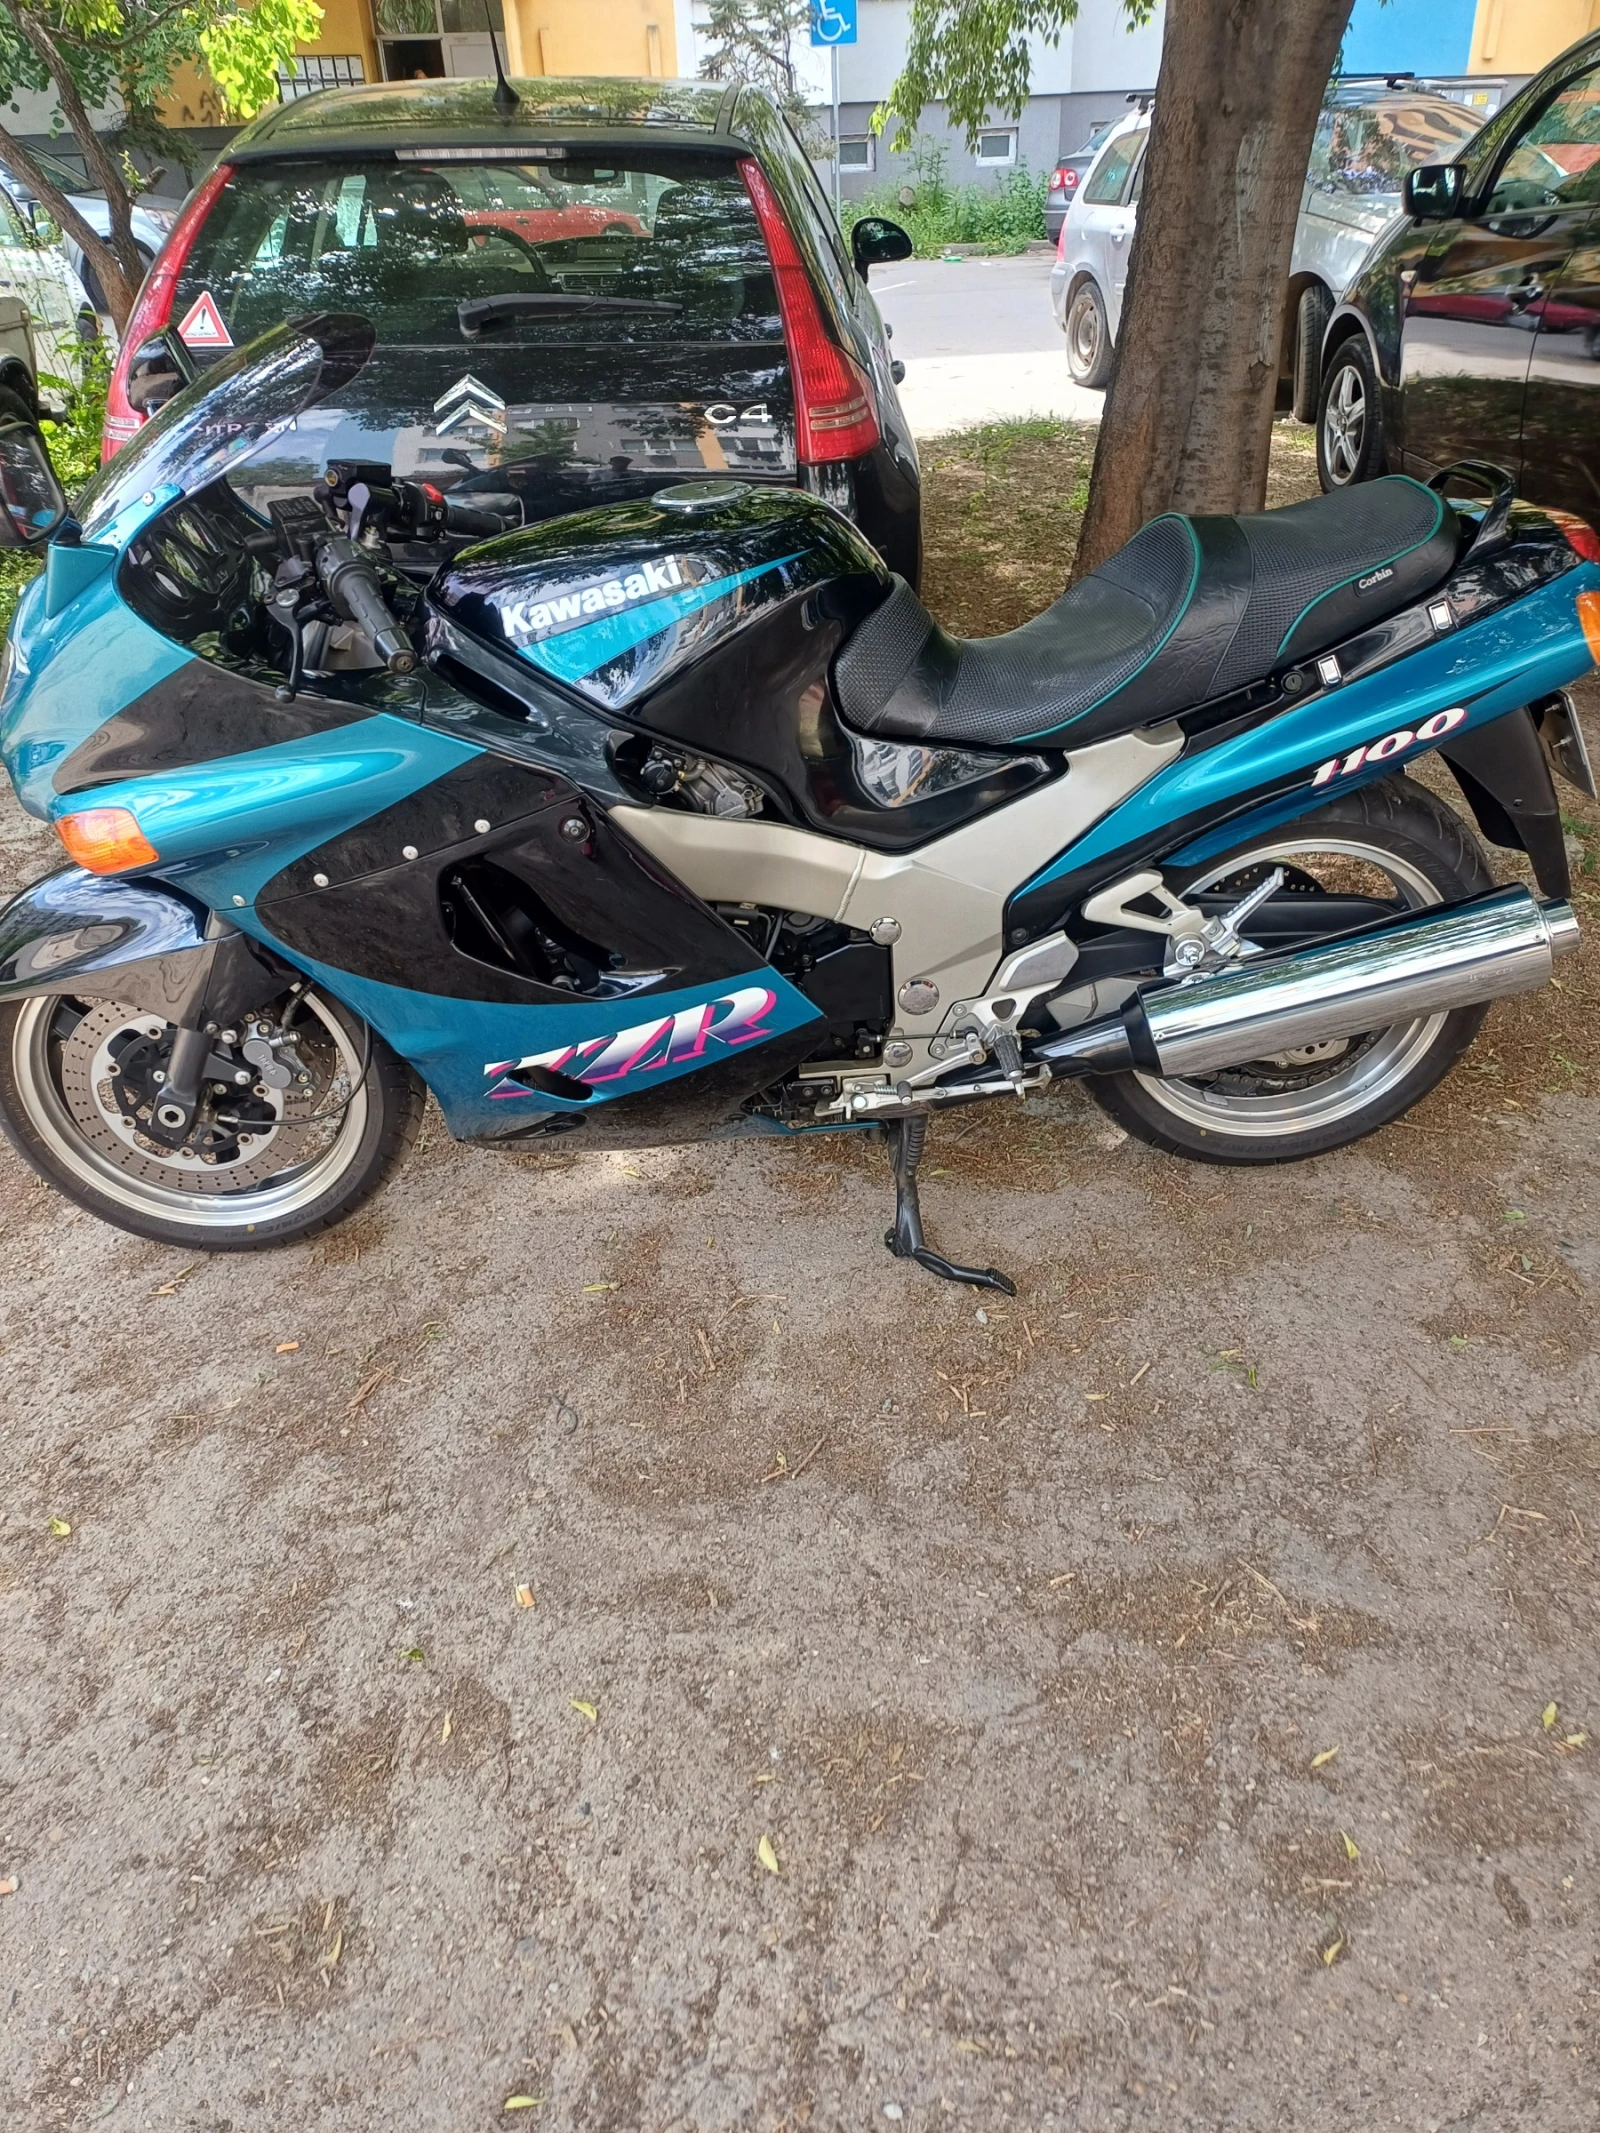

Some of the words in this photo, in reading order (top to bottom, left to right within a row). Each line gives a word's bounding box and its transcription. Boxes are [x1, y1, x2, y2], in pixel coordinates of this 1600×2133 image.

[704, 403, 773, 424] C4
[500, 555, 684, 638] Kawasaki
[1358, 568, 1394, 589] Corbin
[1311, 707, 1468, 788] 1100
[484, 986, 777, 1099] ZZR
